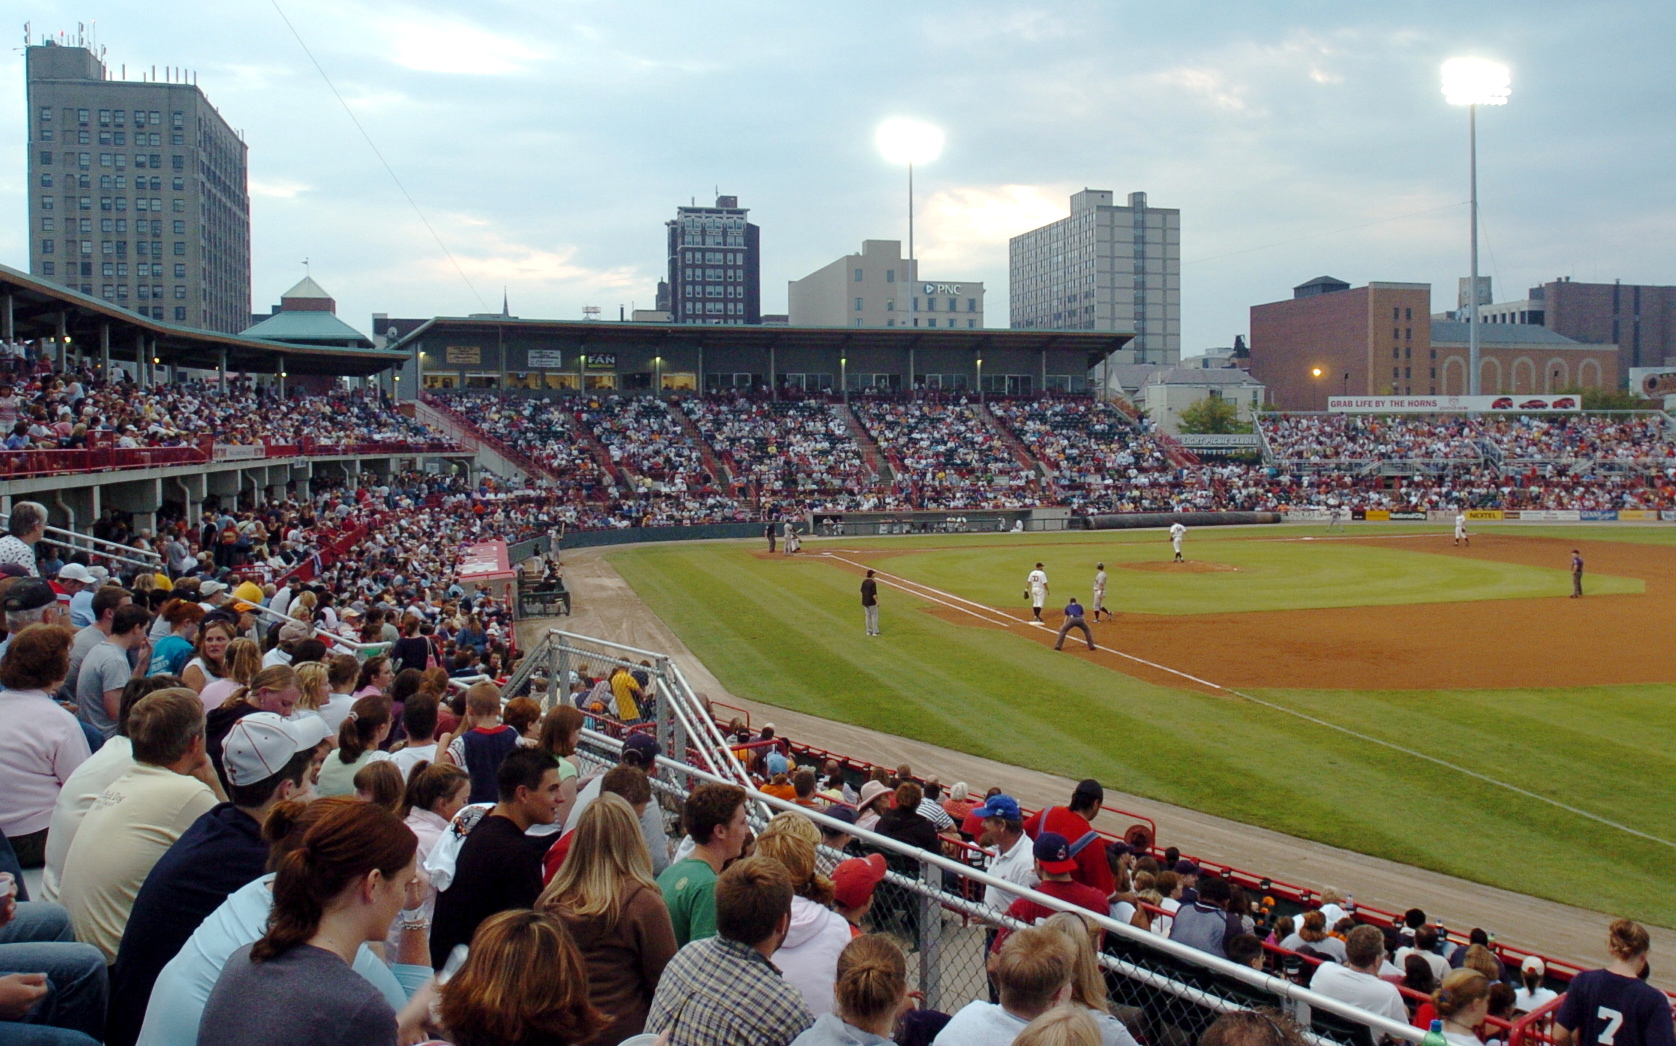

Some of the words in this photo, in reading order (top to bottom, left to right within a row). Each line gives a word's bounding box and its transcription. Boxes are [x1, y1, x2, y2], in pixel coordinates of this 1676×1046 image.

[937, 284, 961, 295] PNC
[588, 356, 615, 364] FAN
[1330, 400, 1353, 408] GRAB
[1355, 400, 1373, 408] LIFE
[1407, 399, 1437, 407] HORNS
[1182, 437, 1204, 445] LIGHT
[1205, 437, 1229, 445] PICNIC
[1230, 437, 1258, 445] GARDEN
[1597, 1005, 1623, 1046] 7
